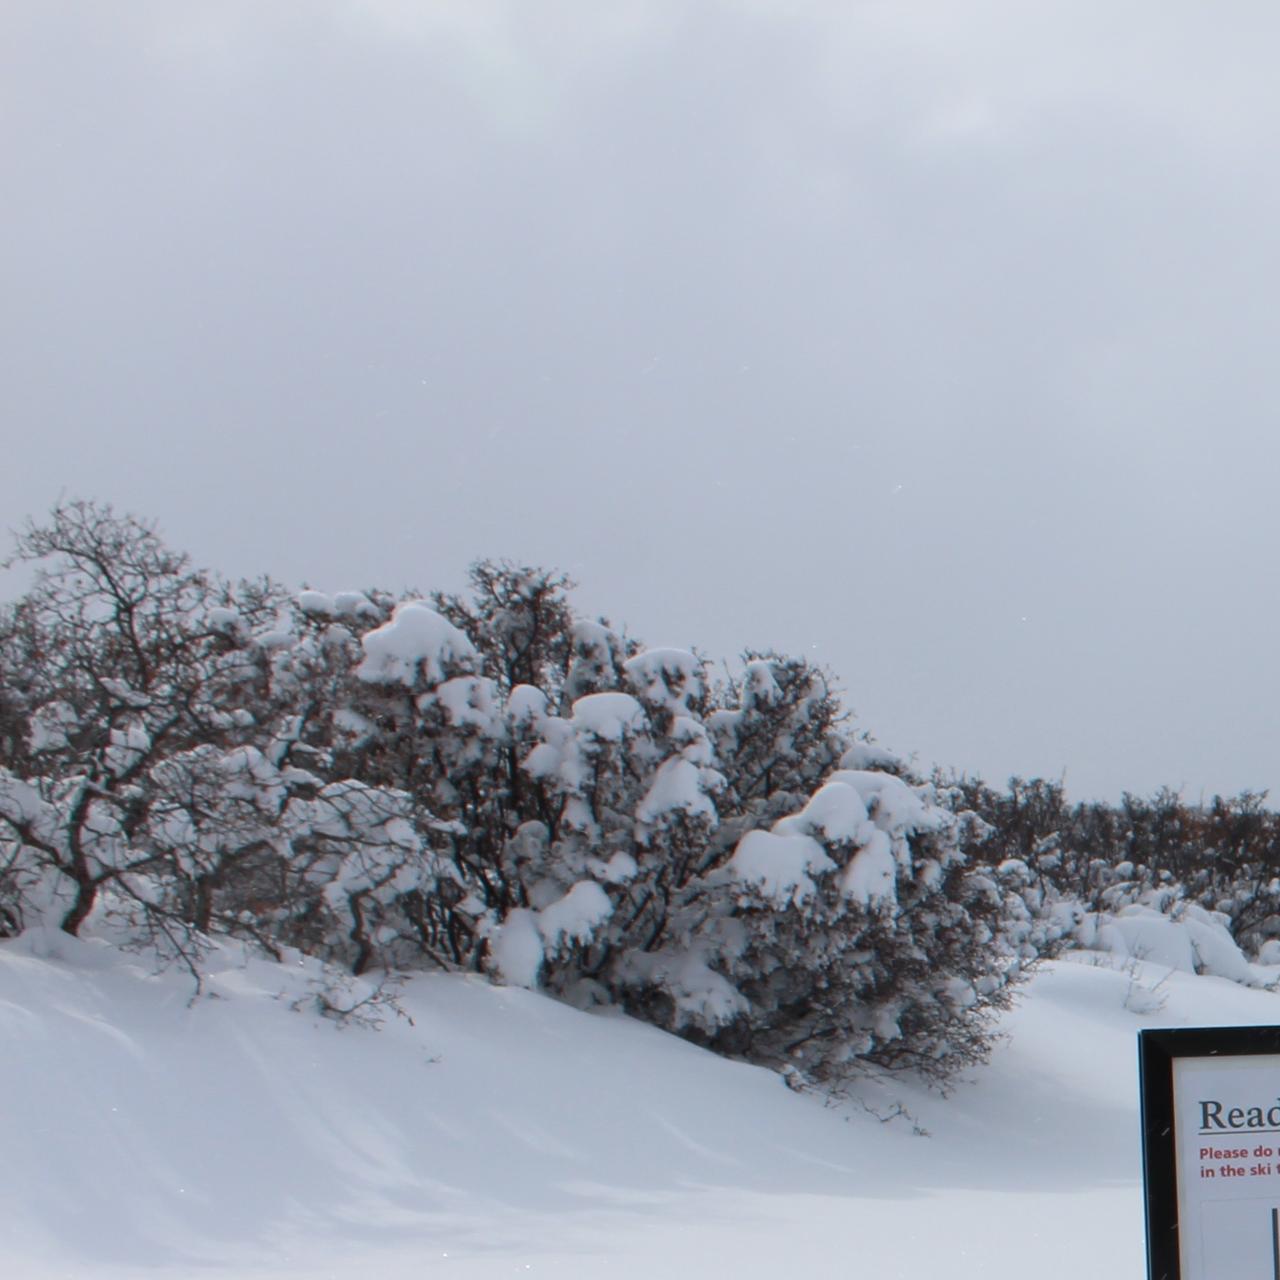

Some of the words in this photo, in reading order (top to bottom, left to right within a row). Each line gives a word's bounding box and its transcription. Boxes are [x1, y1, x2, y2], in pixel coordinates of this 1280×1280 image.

[1200, 1147, 1249, 1160] Please
[1253, 1145, 1273, 1157] do
[1200, 1165, 1216, 1178] in
[1220, 1164, 1246, 1177] the
[1249, 1163, 1272, 1176] ski
